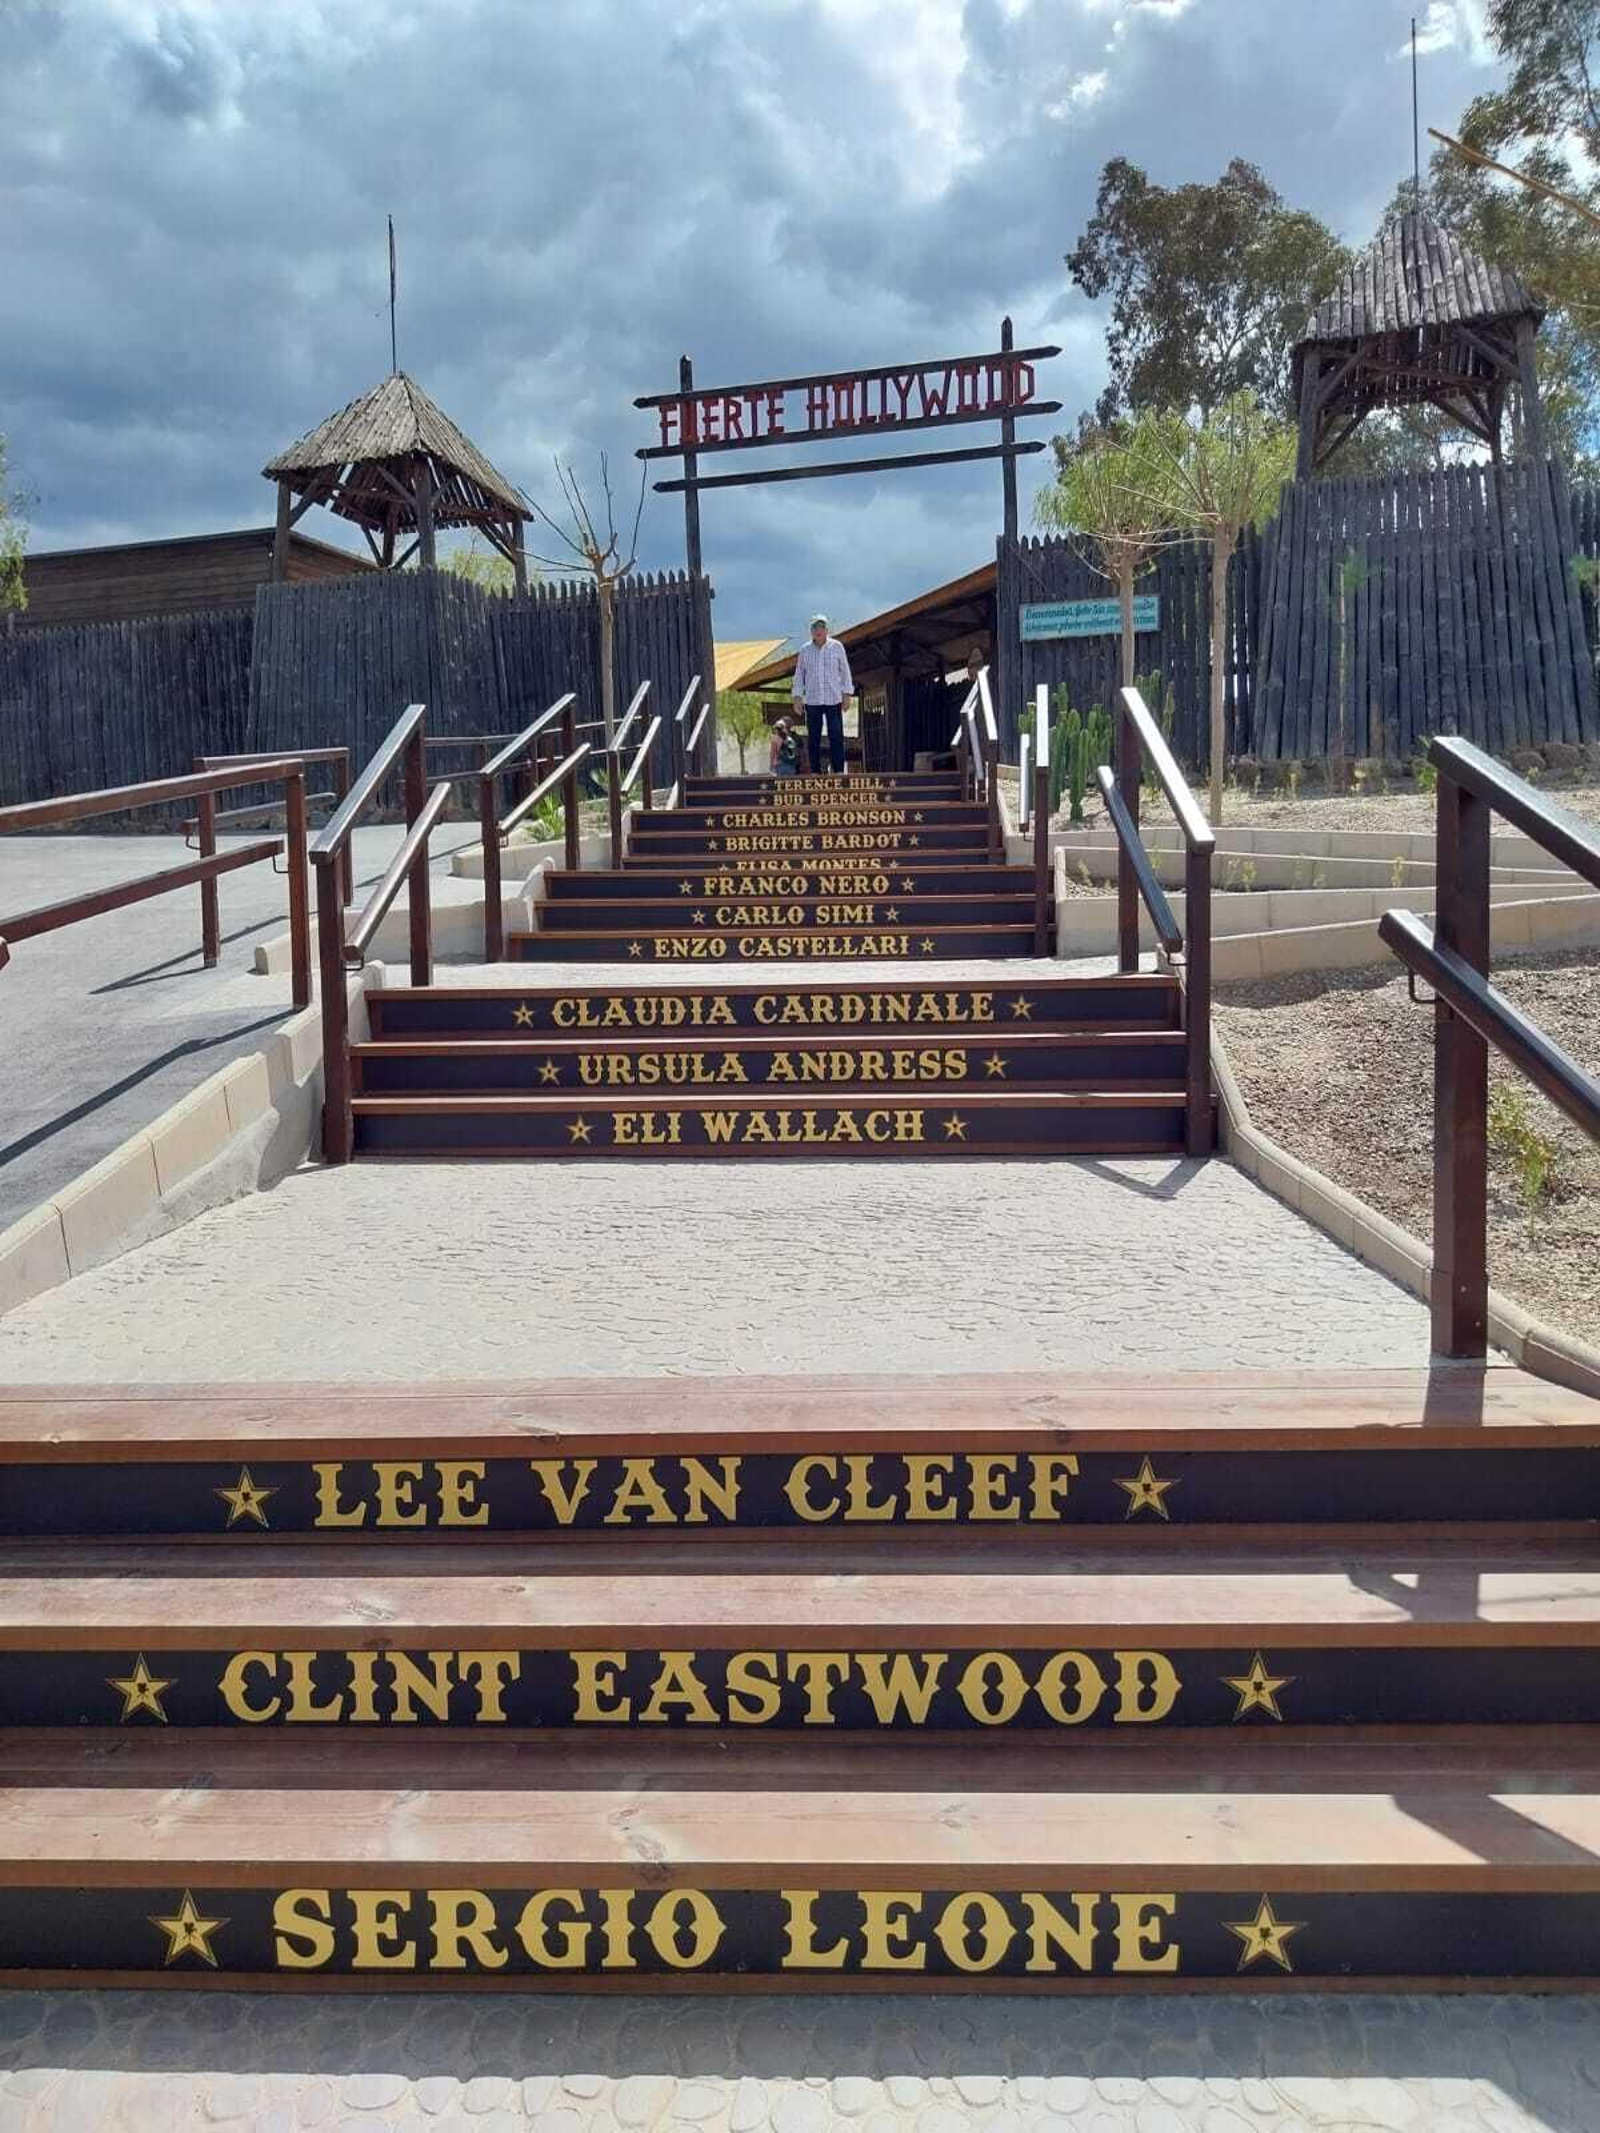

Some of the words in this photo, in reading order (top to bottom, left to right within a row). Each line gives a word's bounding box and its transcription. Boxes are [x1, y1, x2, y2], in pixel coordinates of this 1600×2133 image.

[807, 361, 1036, 429] HOLLYWOOD
[774, 778, 842, 791] TERENCE
[848, 777, 884, 790] HILL
[774, 792, 804, 805] BUD
[811, 792, 879, 805] SPENCER
[723, 811, 809, 828] CHARLES
[817, 809, 905, 826] BRONSON
[726, 835, 813, 851] BRIGITTE
[822, 833, 901, 850] BARDOT
[703, 876, 808, 896] FRANCO
[819, 874, 890, 894] NERO
[715, 905, 805, 925] CARLO
[816, 904, 875, 924] SIMI
[654, 937, 727, 958] ENZO
[738, 935, 910, 957] CASTELLARI
[552, 997, 737, 1027] CLAUDIA
[752, 992, 995, 1025] CARDINALE
[577, 1053, 749, 1085] URSULA
[766, 1049, 969, 1081] ANDRESS
[612, 1111, 682, 1143] ELI
[701, 1110, 925, 1143] WALLACH
[312, 1461, 490, 1527] LEE
[530, 1457, 742, 1524] VAN
[783, 1453, 1080, 1522] CLEEF
[217, 1650, 523, 1723] CLINT
[570, 1649, 1182, 1725] EASTWOOD
[271, 1888, 724, 1970] SERGIO
[780, 1889, 1180, 1973] LEONE
